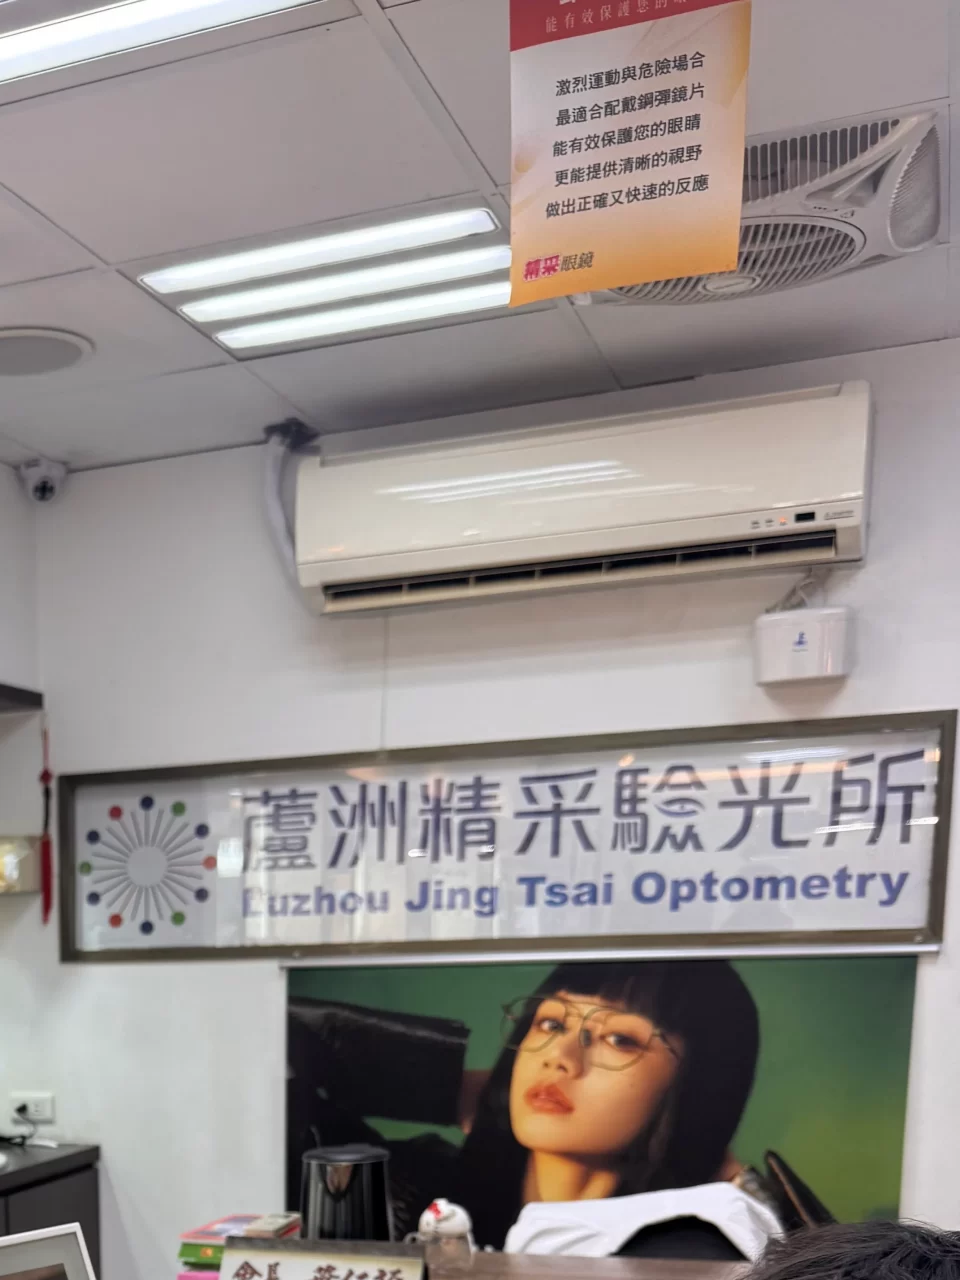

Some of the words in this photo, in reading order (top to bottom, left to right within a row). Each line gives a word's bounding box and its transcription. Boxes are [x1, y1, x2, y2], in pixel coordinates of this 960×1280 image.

[555, 51, 706, 97] 激烈運動與危險場合
[555, 82, 706, 127] 最適合配戴鋼彈鏡片
[552, 114, 702, 158] 能有效保護您的眼睛
[554, 145, 703, 188] 更能提供清晰的視野
[545, 174, 710, 219] 做出正確又快速的反應
[242, 748, 926, 872] 蘆洲精采驗光所
[242, 886, 390, 918] Luzhou
[405, 880, 500, 918] Jing
[517, 873, 614, 908] Tsai
[632, 865, 910, 912] Optometry
